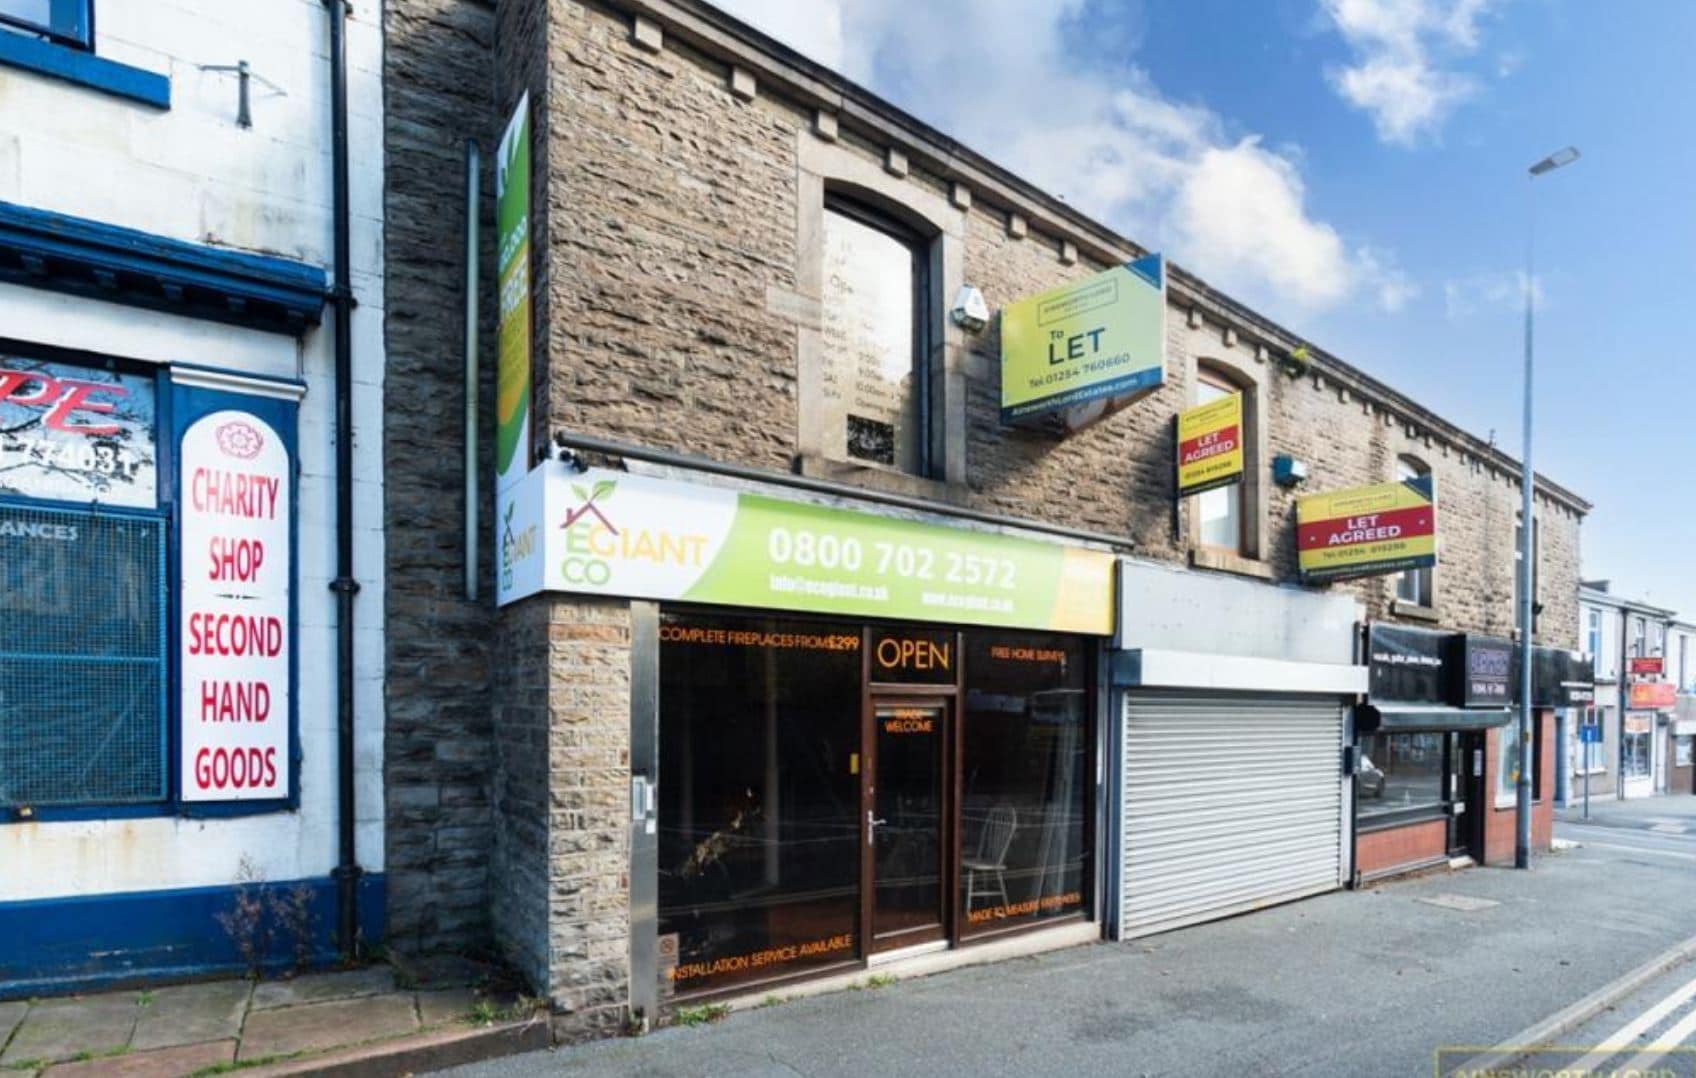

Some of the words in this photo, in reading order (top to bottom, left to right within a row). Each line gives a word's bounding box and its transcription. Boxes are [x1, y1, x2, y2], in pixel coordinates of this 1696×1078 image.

[1049, 327, 1106, 366] LET
[1185, 440, 1234, 462] AGREED
[1198, 432, 1218, 447] LET
[191, 467, 279, 520] CHARITY
[1328, 525, 1401, 545] AGREED
[1347, 514, 1380, 529] LET
[208, 536, 264, 583] SHOP
[768, 527, 862, 571] 0800
[874, 541, 935, 579] 702
[945, 552, 1017, 590] 2572
[188, 612, 282, 657] SECOND
[660, 627, 726, 644] COMPLETE
[729, 631, 794, 647] FIREPLACES
[877, 638, 949, 669] OPEN
[201, 680, 270, 723] HAND
[885, 720, 935, 733] WELCOME
[195, 747, 277, 790] GOODS
[670, 956, 748, 980] INSTALLATION
[751, 945, 798, 966] SERVICE
[800, 934, 853, 954] AVAILABLE
